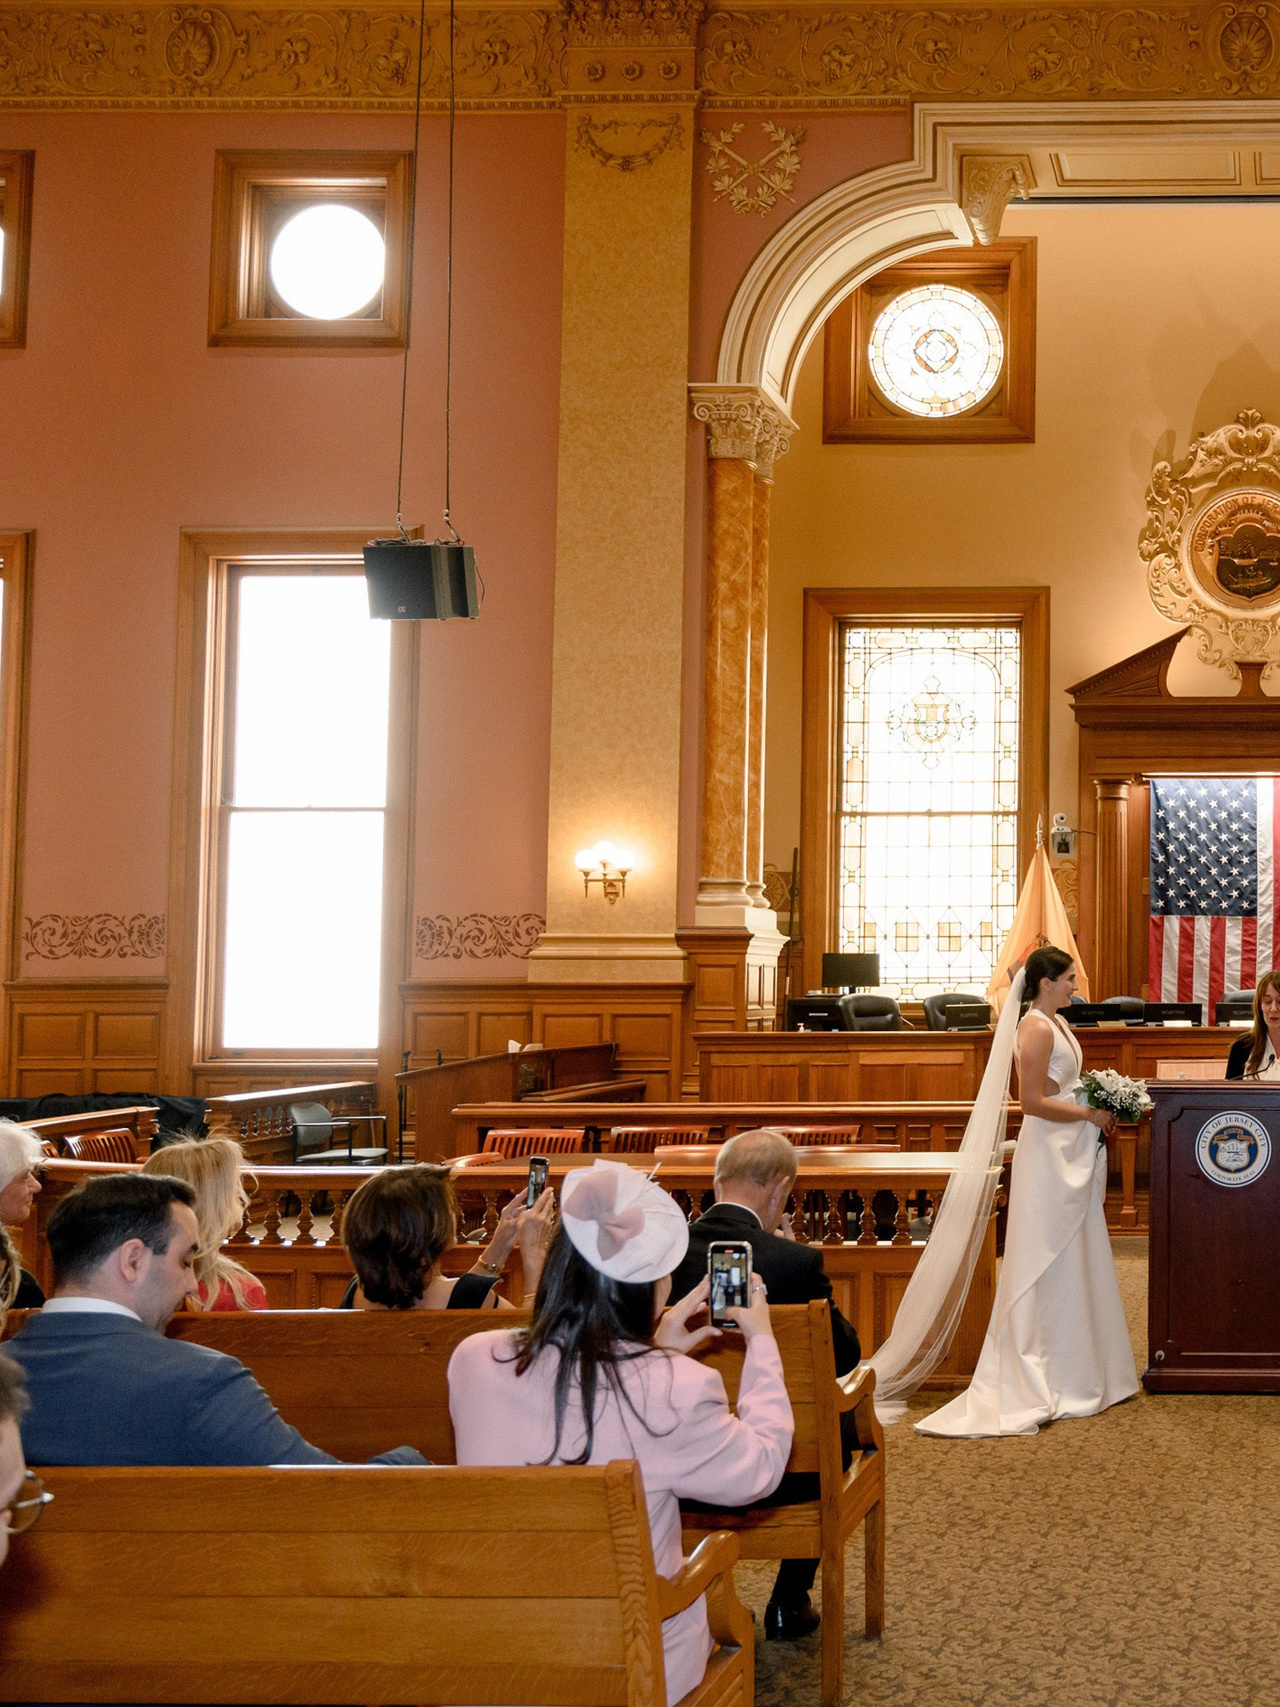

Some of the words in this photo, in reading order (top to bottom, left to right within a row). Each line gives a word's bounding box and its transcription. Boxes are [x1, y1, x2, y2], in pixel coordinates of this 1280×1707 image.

[1195, 498, 1239, 553] CORPORATION
[1241, 497, 1257, 505] OF
[1201, 1129, 1211, 1149] CITY
[1211, 1120, 1222, 1129] OF
[1224, 1116, 1253, 1128] JERSEY
[1254, 1128, 1266, 1148] CITY
